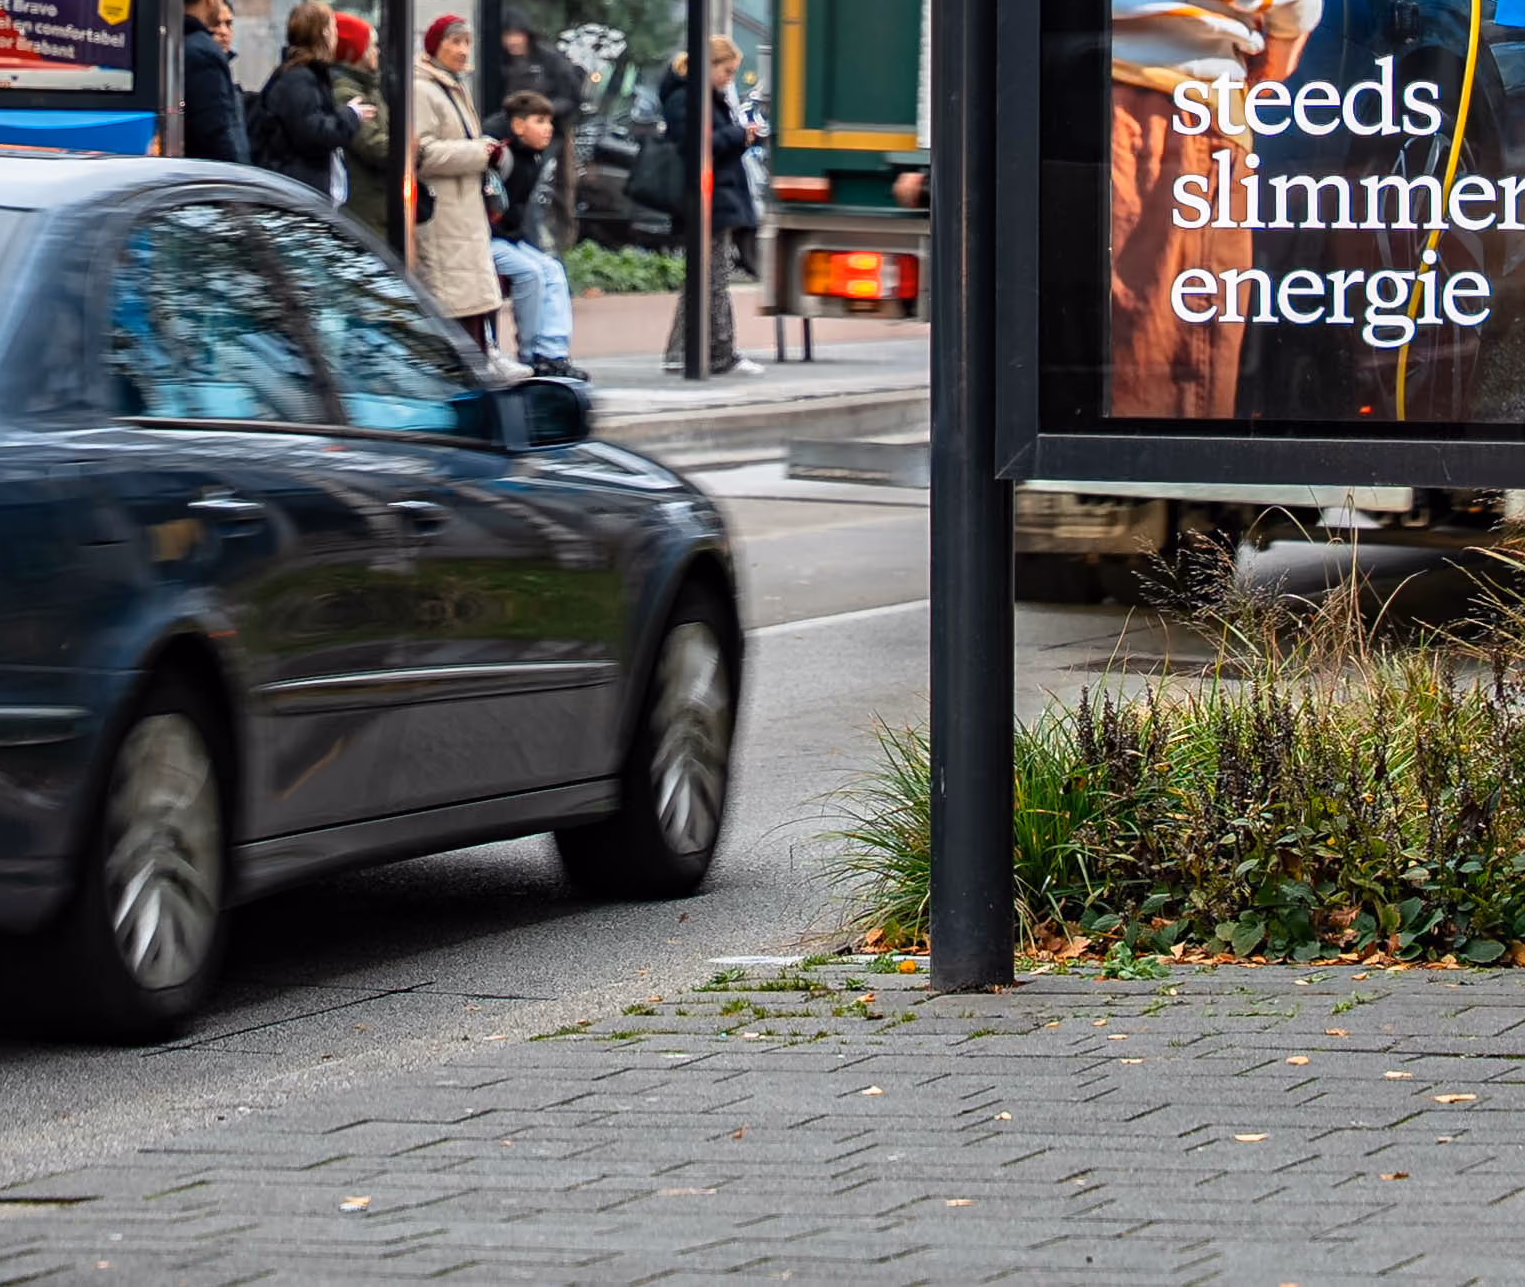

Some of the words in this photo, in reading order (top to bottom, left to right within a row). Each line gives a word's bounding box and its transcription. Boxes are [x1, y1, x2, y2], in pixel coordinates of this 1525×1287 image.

[16, 36, 75, 59] Brabant
[35, 21, 125, 48] comfortabel
[1172, 55, 1443, 136] steeds
[1171, 249, 1492, 349] energie
